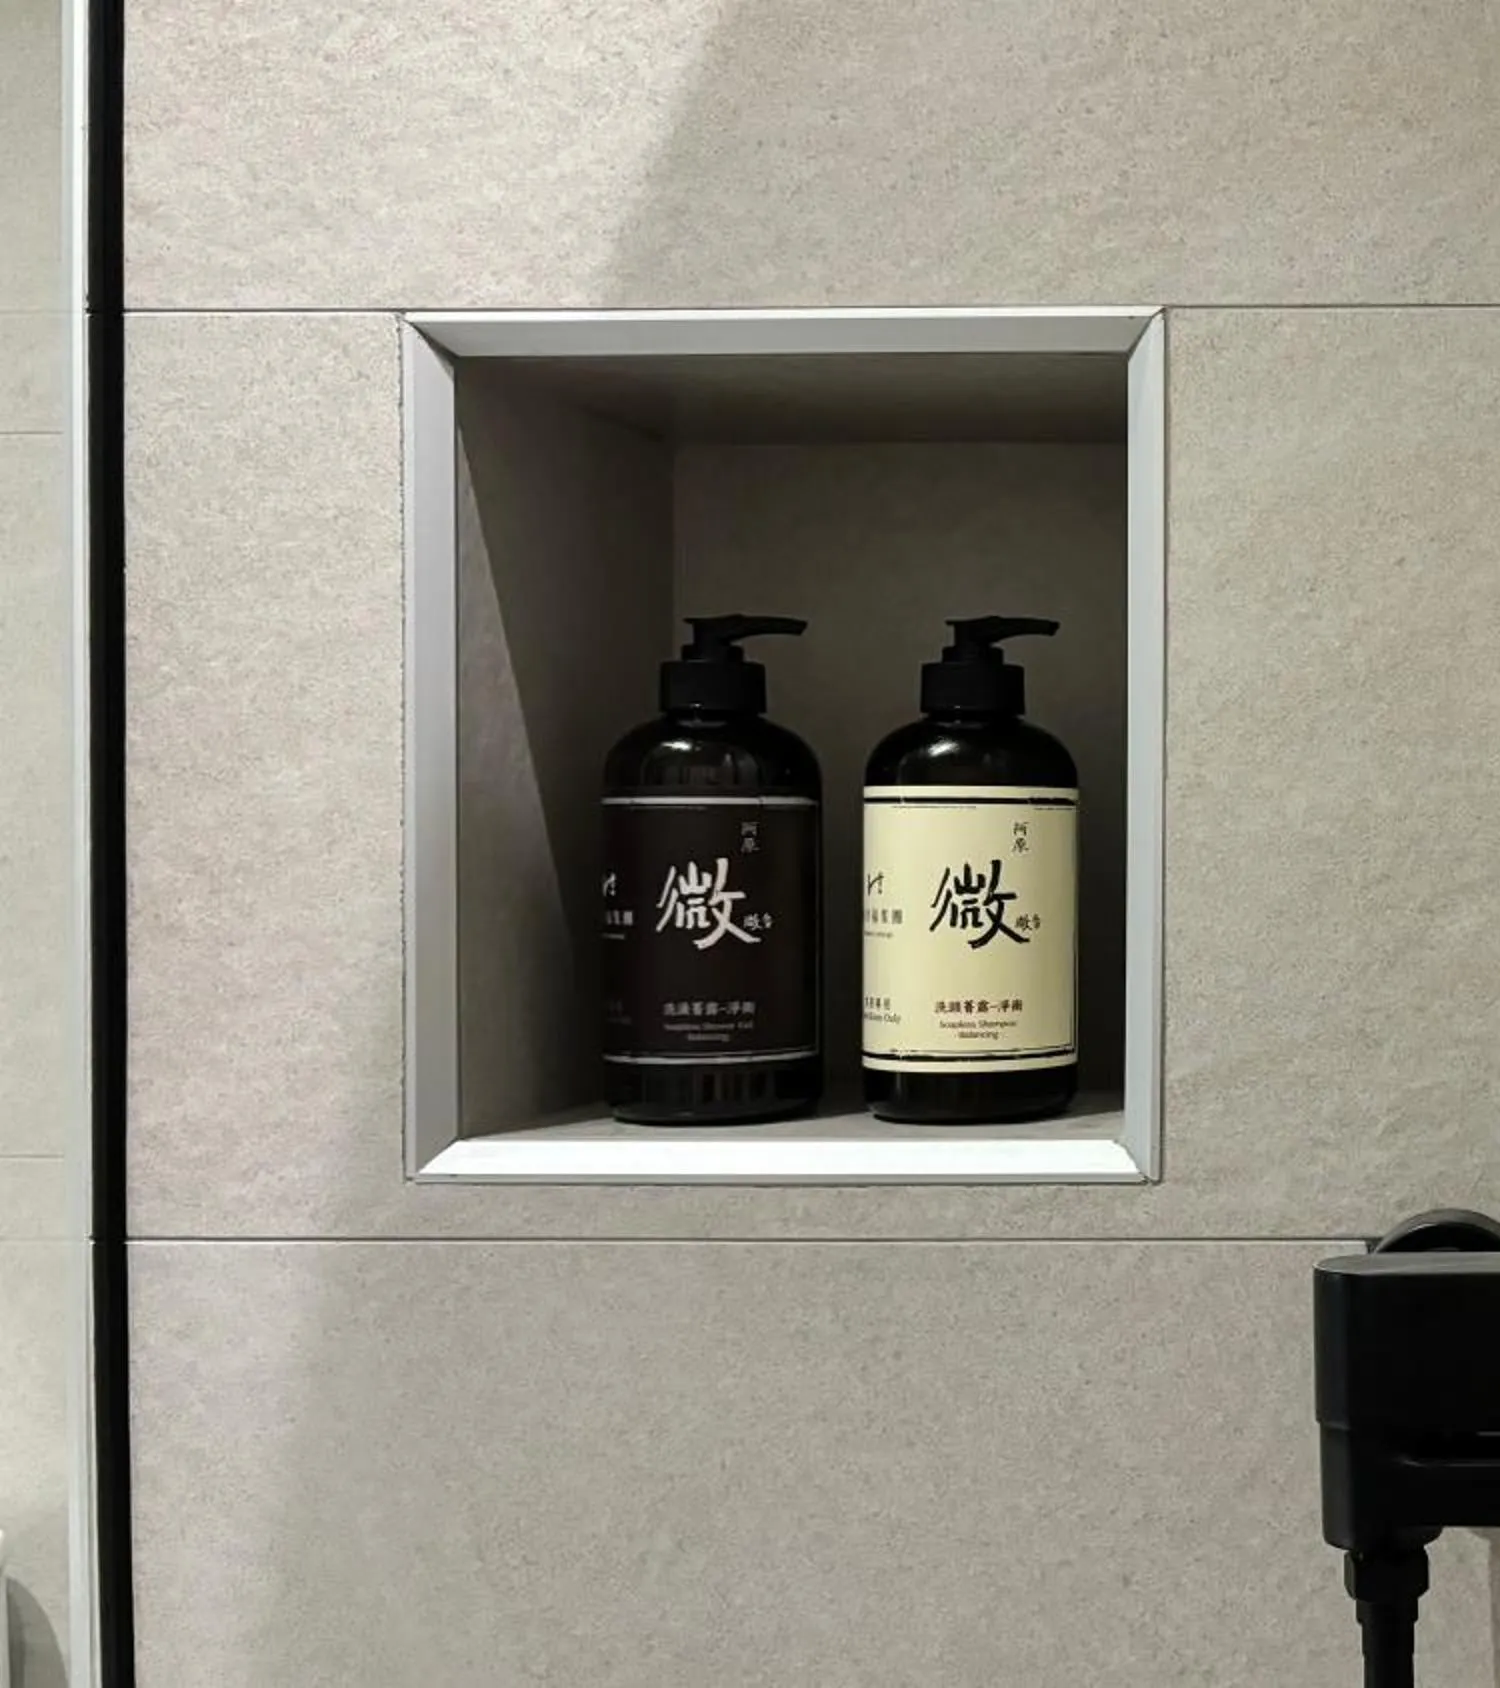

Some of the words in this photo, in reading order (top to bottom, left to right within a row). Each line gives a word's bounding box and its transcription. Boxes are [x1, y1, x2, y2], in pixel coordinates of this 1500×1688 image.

[1012, 821, 1029, 853] 阿原
[656, 857, 761, 950] 微
[929, 858, 1030, 950] 微
